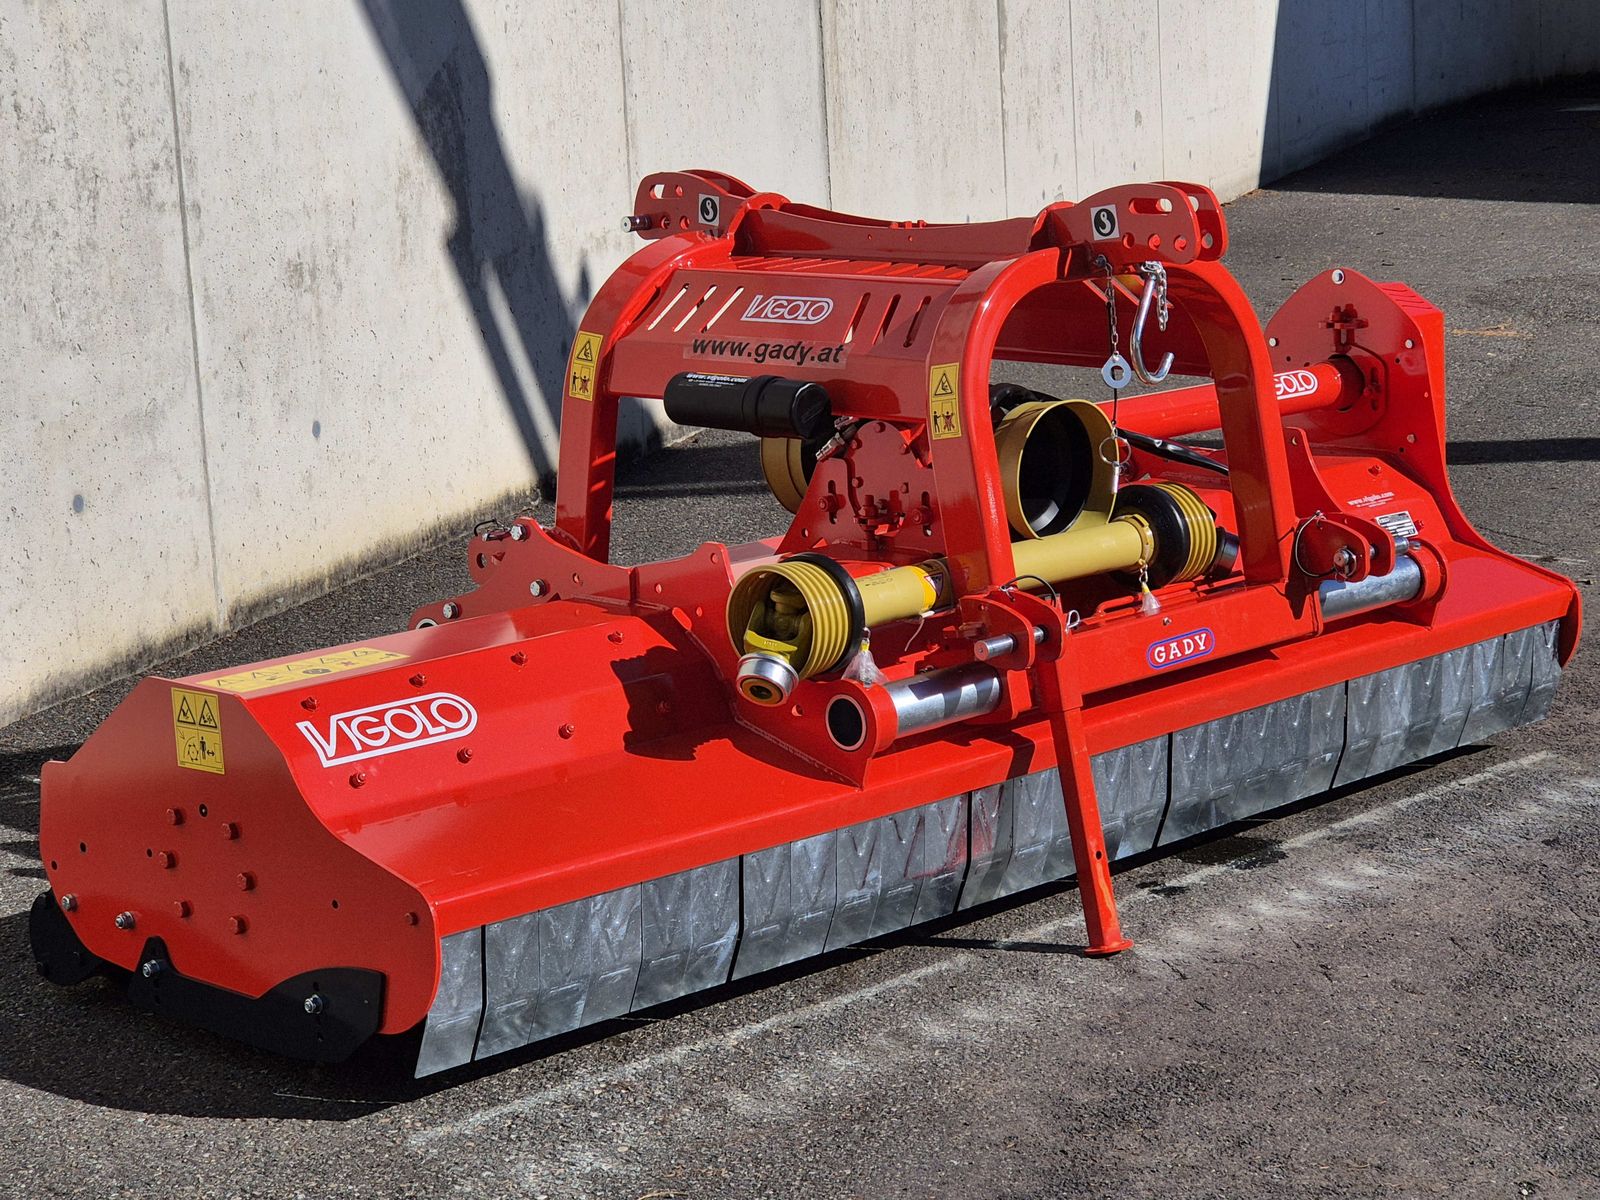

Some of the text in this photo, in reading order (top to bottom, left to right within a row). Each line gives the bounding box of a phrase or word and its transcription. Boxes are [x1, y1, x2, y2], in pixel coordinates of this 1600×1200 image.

[741, 295, 833, 324] VIGOLO
[692, 338, 845, 366] www.gady.at
[1273, 371, 1317, 398] GOLO
[1154, 633, 1206, 663] GADY
[296, 693, 478, 768] VIGOLO
